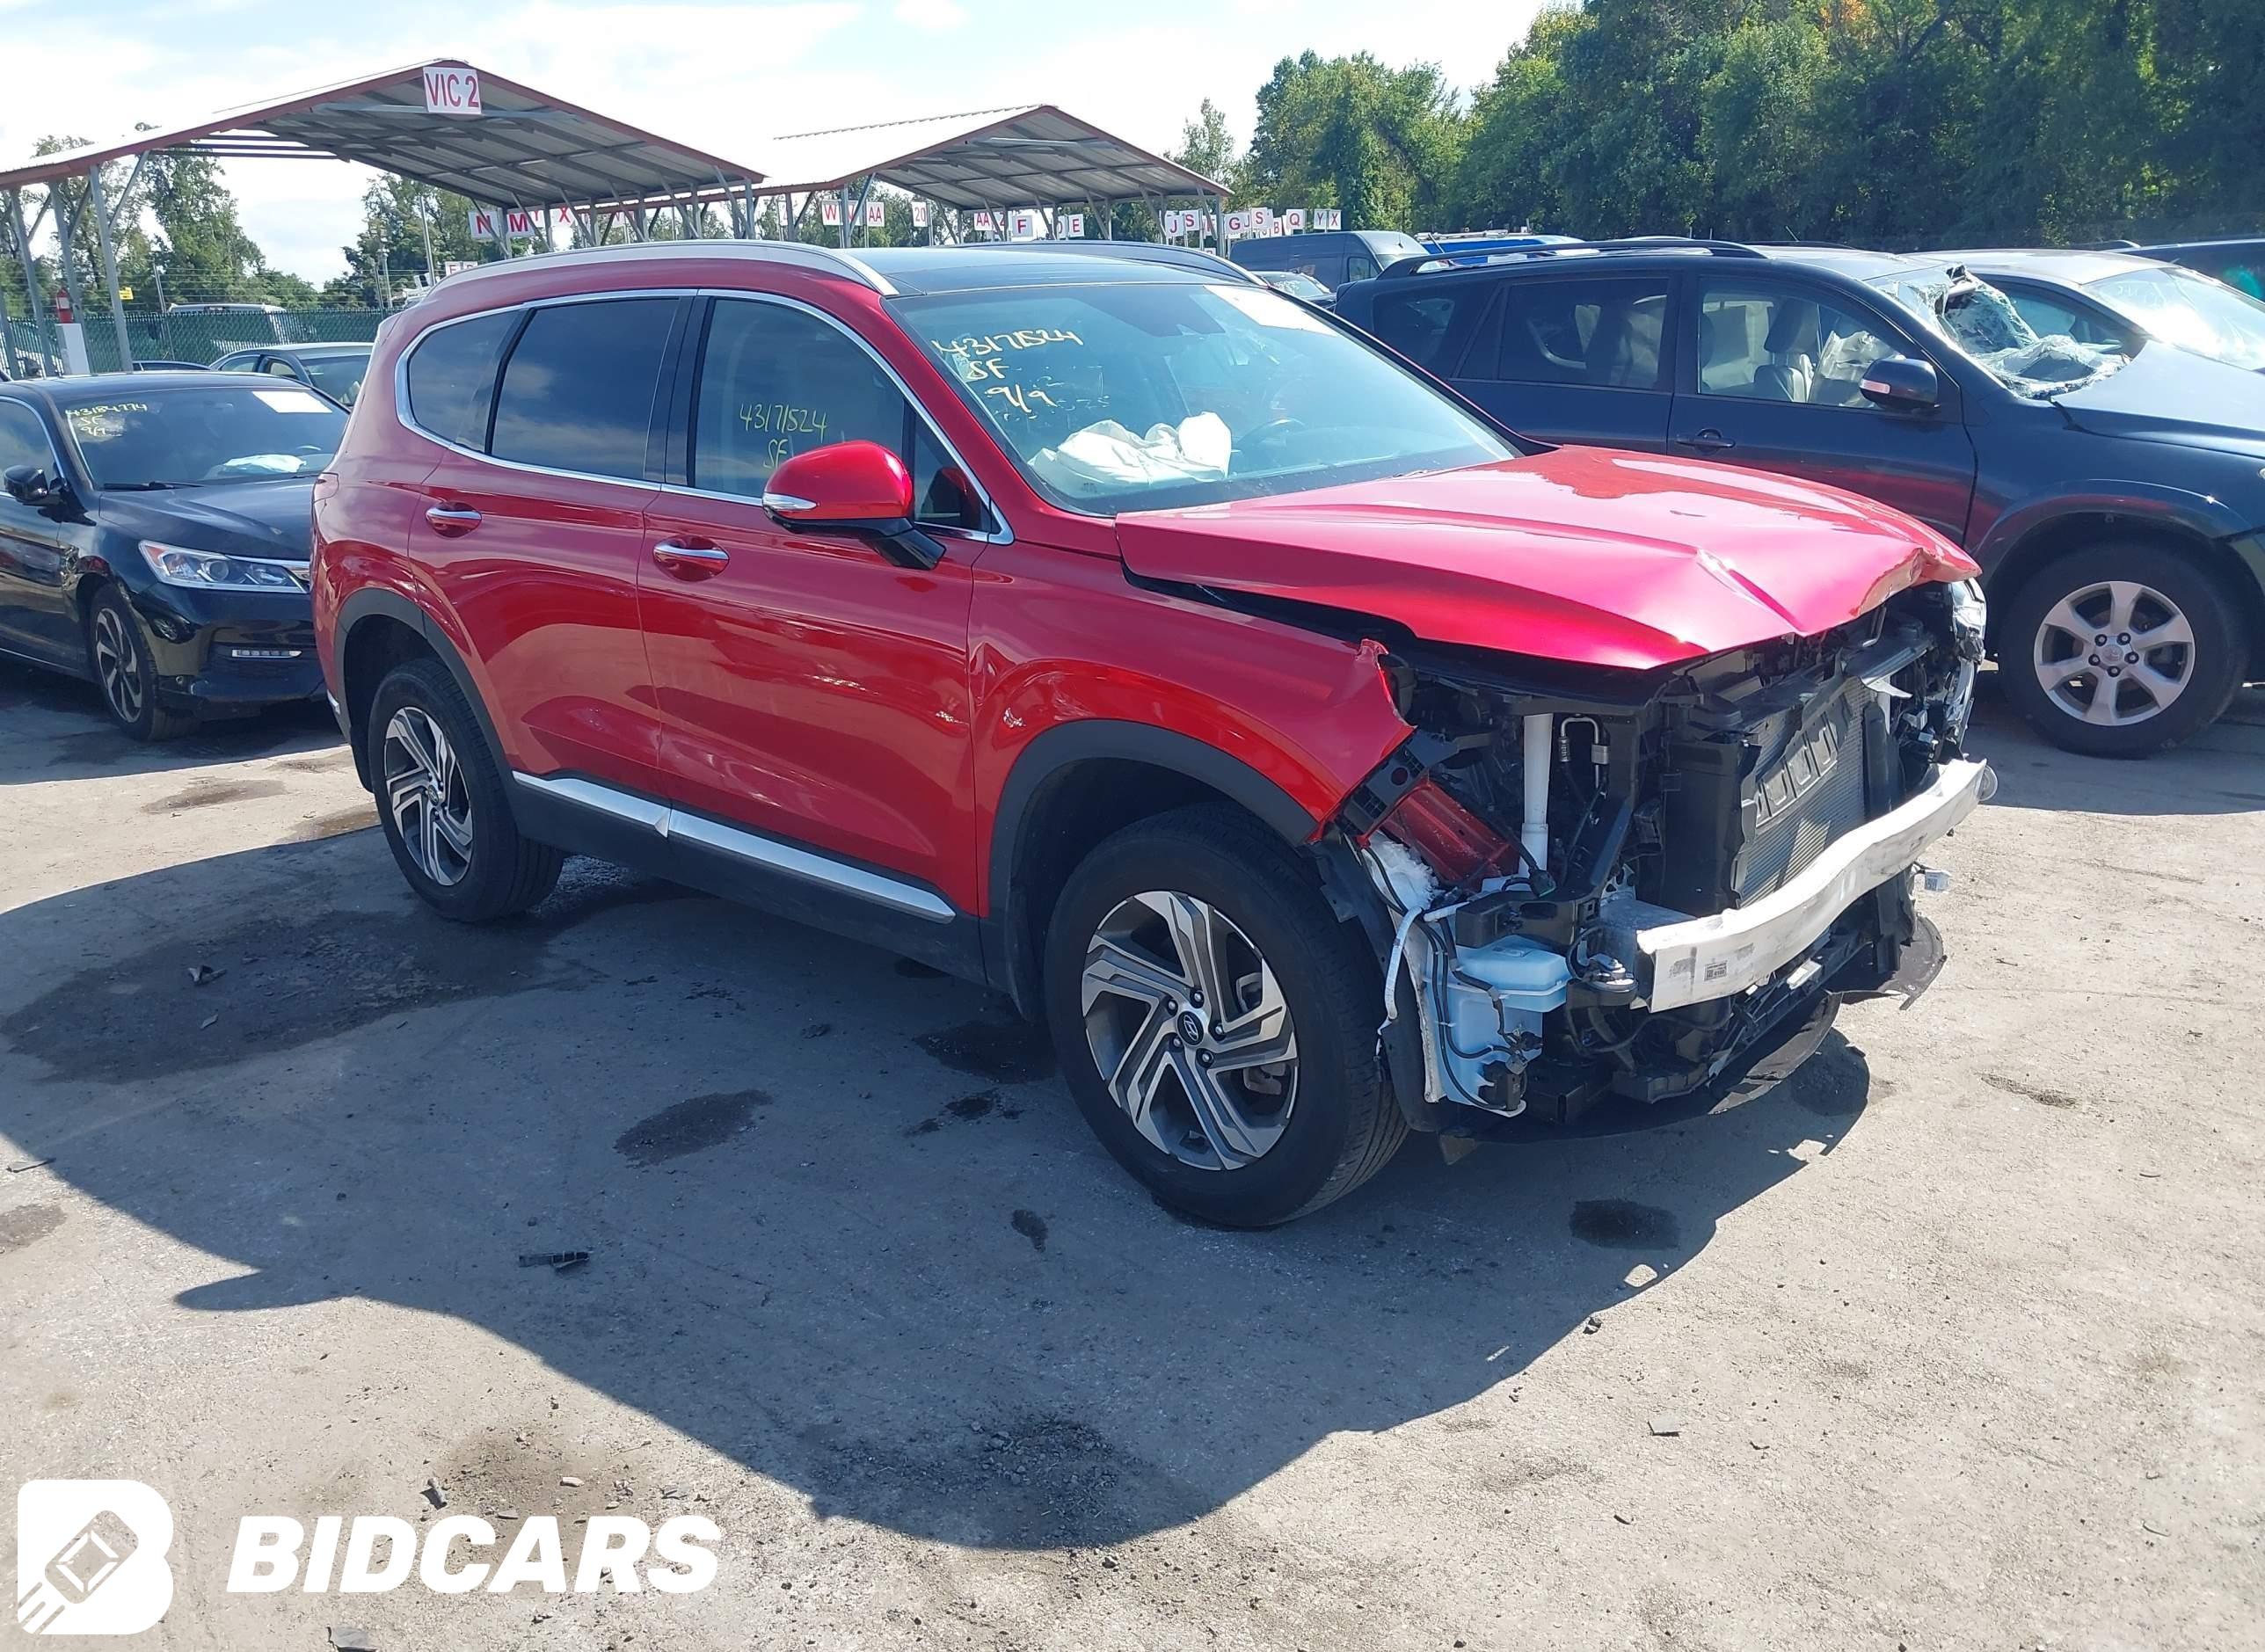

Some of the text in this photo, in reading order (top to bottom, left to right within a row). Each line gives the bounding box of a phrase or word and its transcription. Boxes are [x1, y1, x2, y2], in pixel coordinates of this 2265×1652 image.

[425, 73, 480, 108] VIC 2
[559, 205, 572, 223] X
[825, 204, 837, 221] W
[868, 206, 883, 222] AA
[914, 207, 926, 222] 20
[976, 213, 990, 227] AA
[1256, 211, 1264, 225] S
[1289, 213, 1300, 227] Q
[1316, 212, 1324, 226] Y
[1331, 213, 1338, 227] X
[476, 215, 492, 234] N
[509, 214, 529, 233] M
[1017, 219, 1027, 234] F
[1073, 218, 1081, 233] E
[1169, 219, 1177, 234] J
[1185, 214, 1195, 227] S
[1228, 216, 1241, 230] G
[1243, 215, 1250, 228] J
